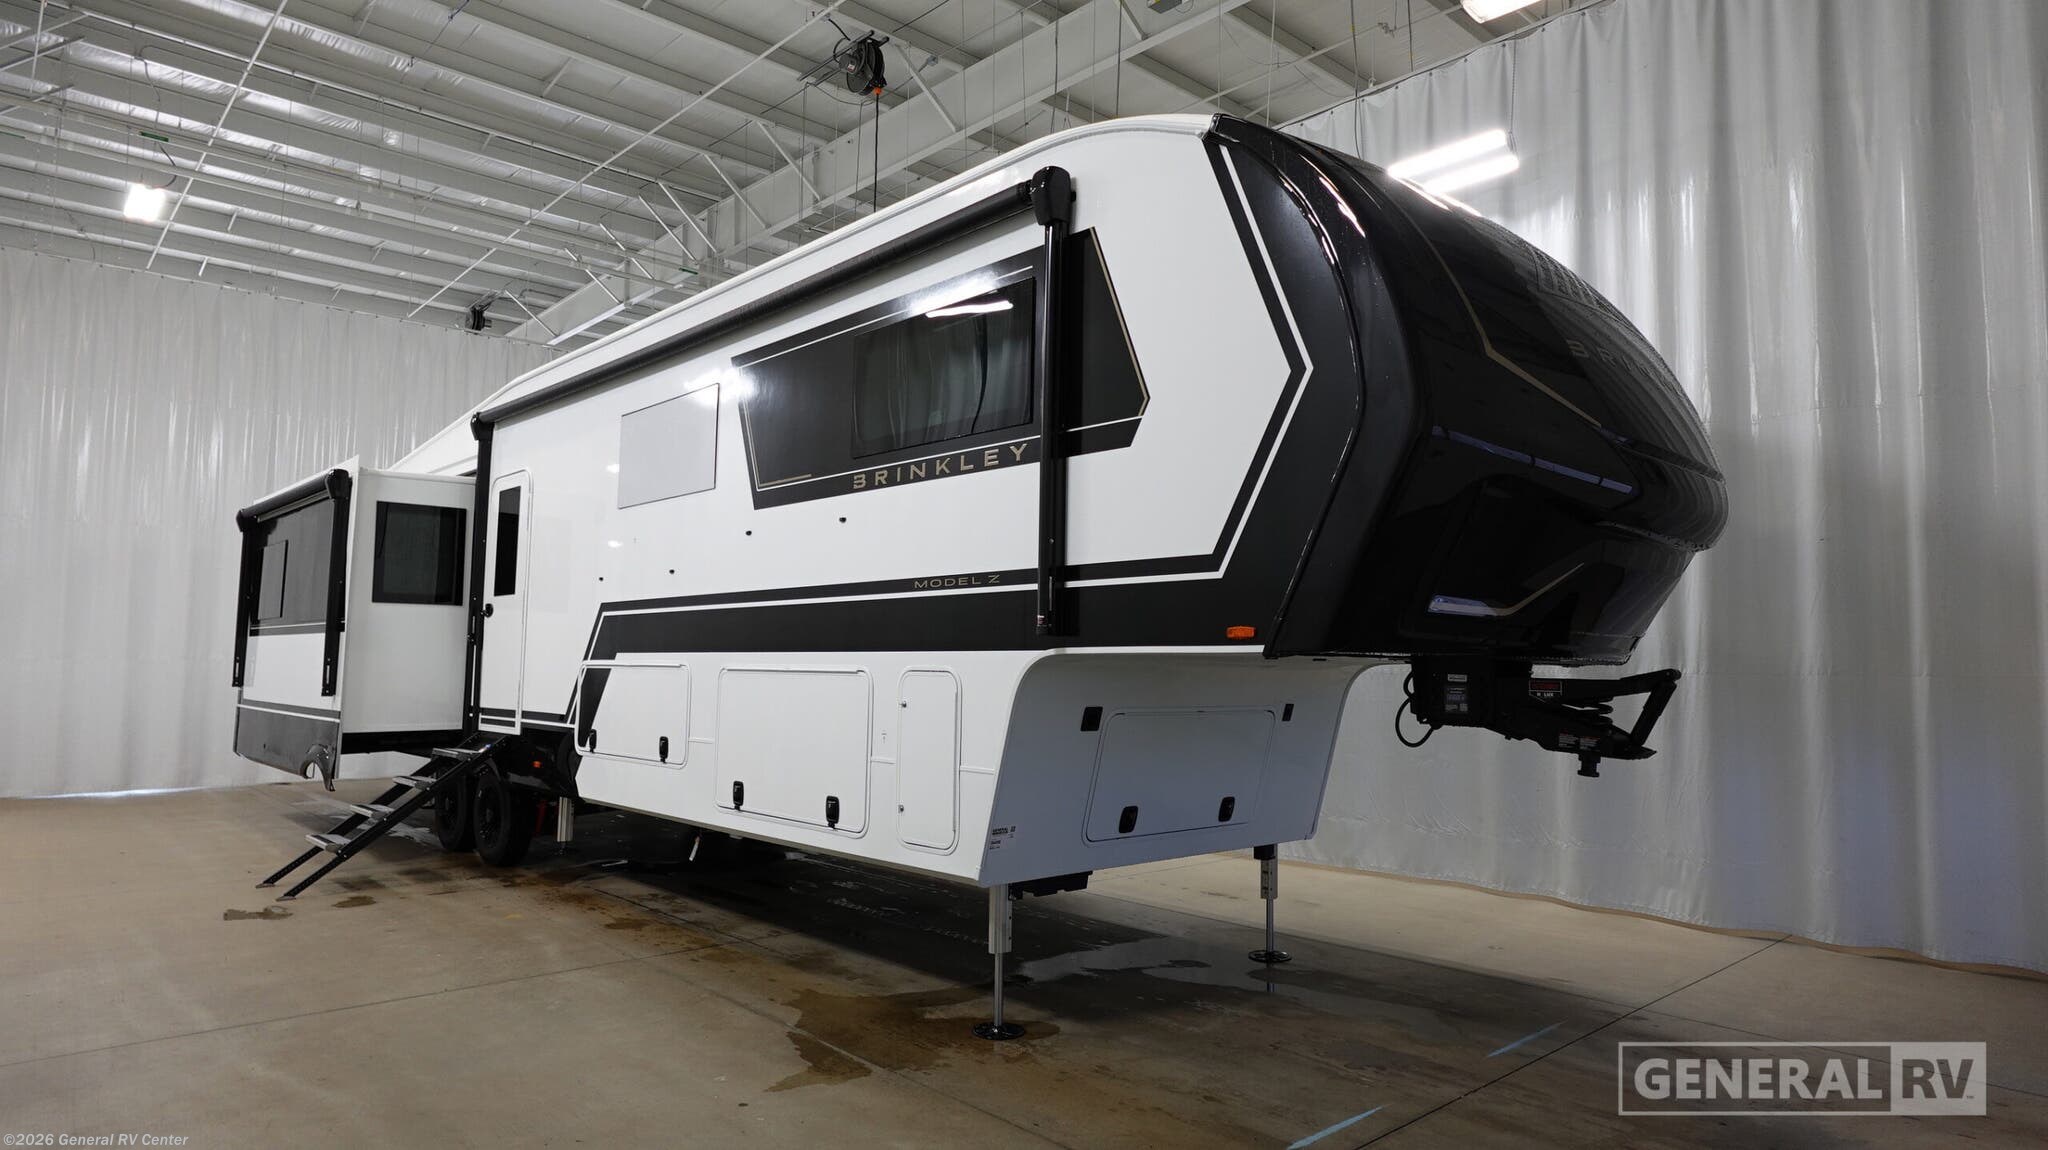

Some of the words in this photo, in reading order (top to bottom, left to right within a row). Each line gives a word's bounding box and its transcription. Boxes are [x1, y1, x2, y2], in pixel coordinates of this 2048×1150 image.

[852, 443, 1028, 490] BRINKLEY
[914, 576, 982, 589] MODEL
[988, 574, 1001, 584] Z
